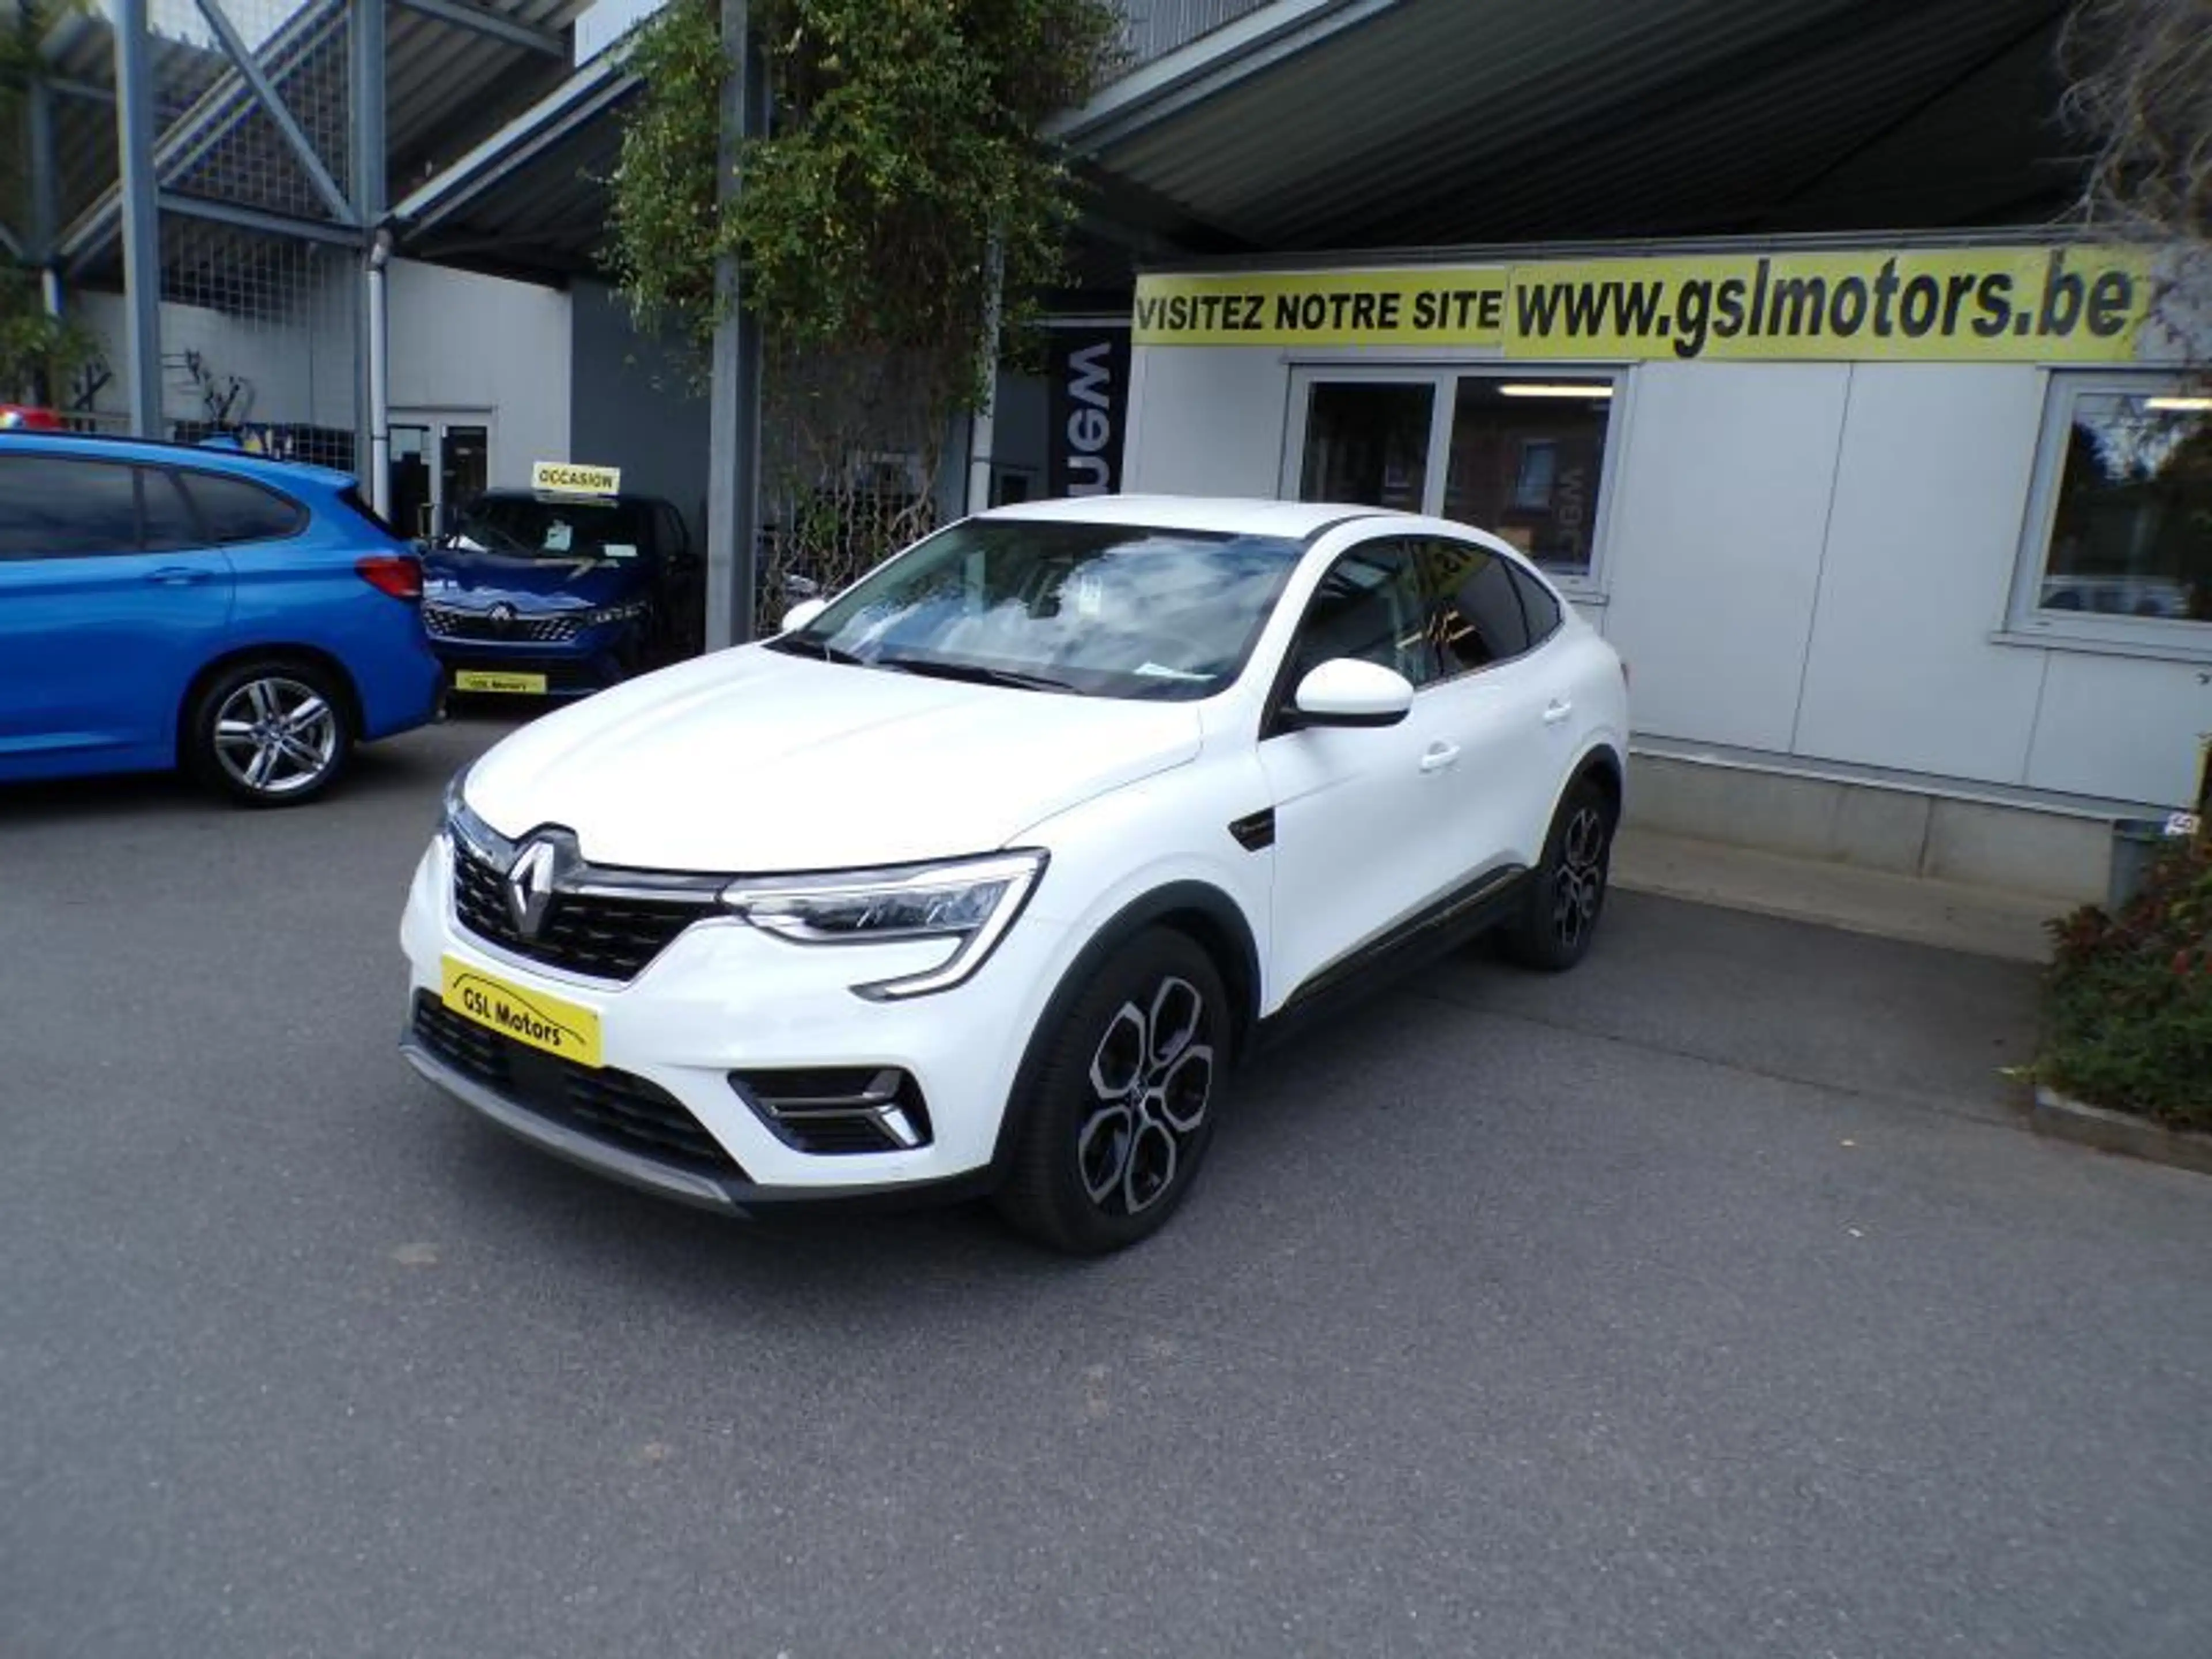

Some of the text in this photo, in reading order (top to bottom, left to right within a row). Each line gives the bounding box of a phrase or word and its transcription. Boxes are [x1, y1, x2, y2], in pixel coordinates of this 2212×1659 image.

[1137, 291, 1502, 331] VISITEZ NOTRE SITE
[1517, 250, 2135, 357] www.gslmotors.be
[464, 987, 562, 1046] GSL Motors
